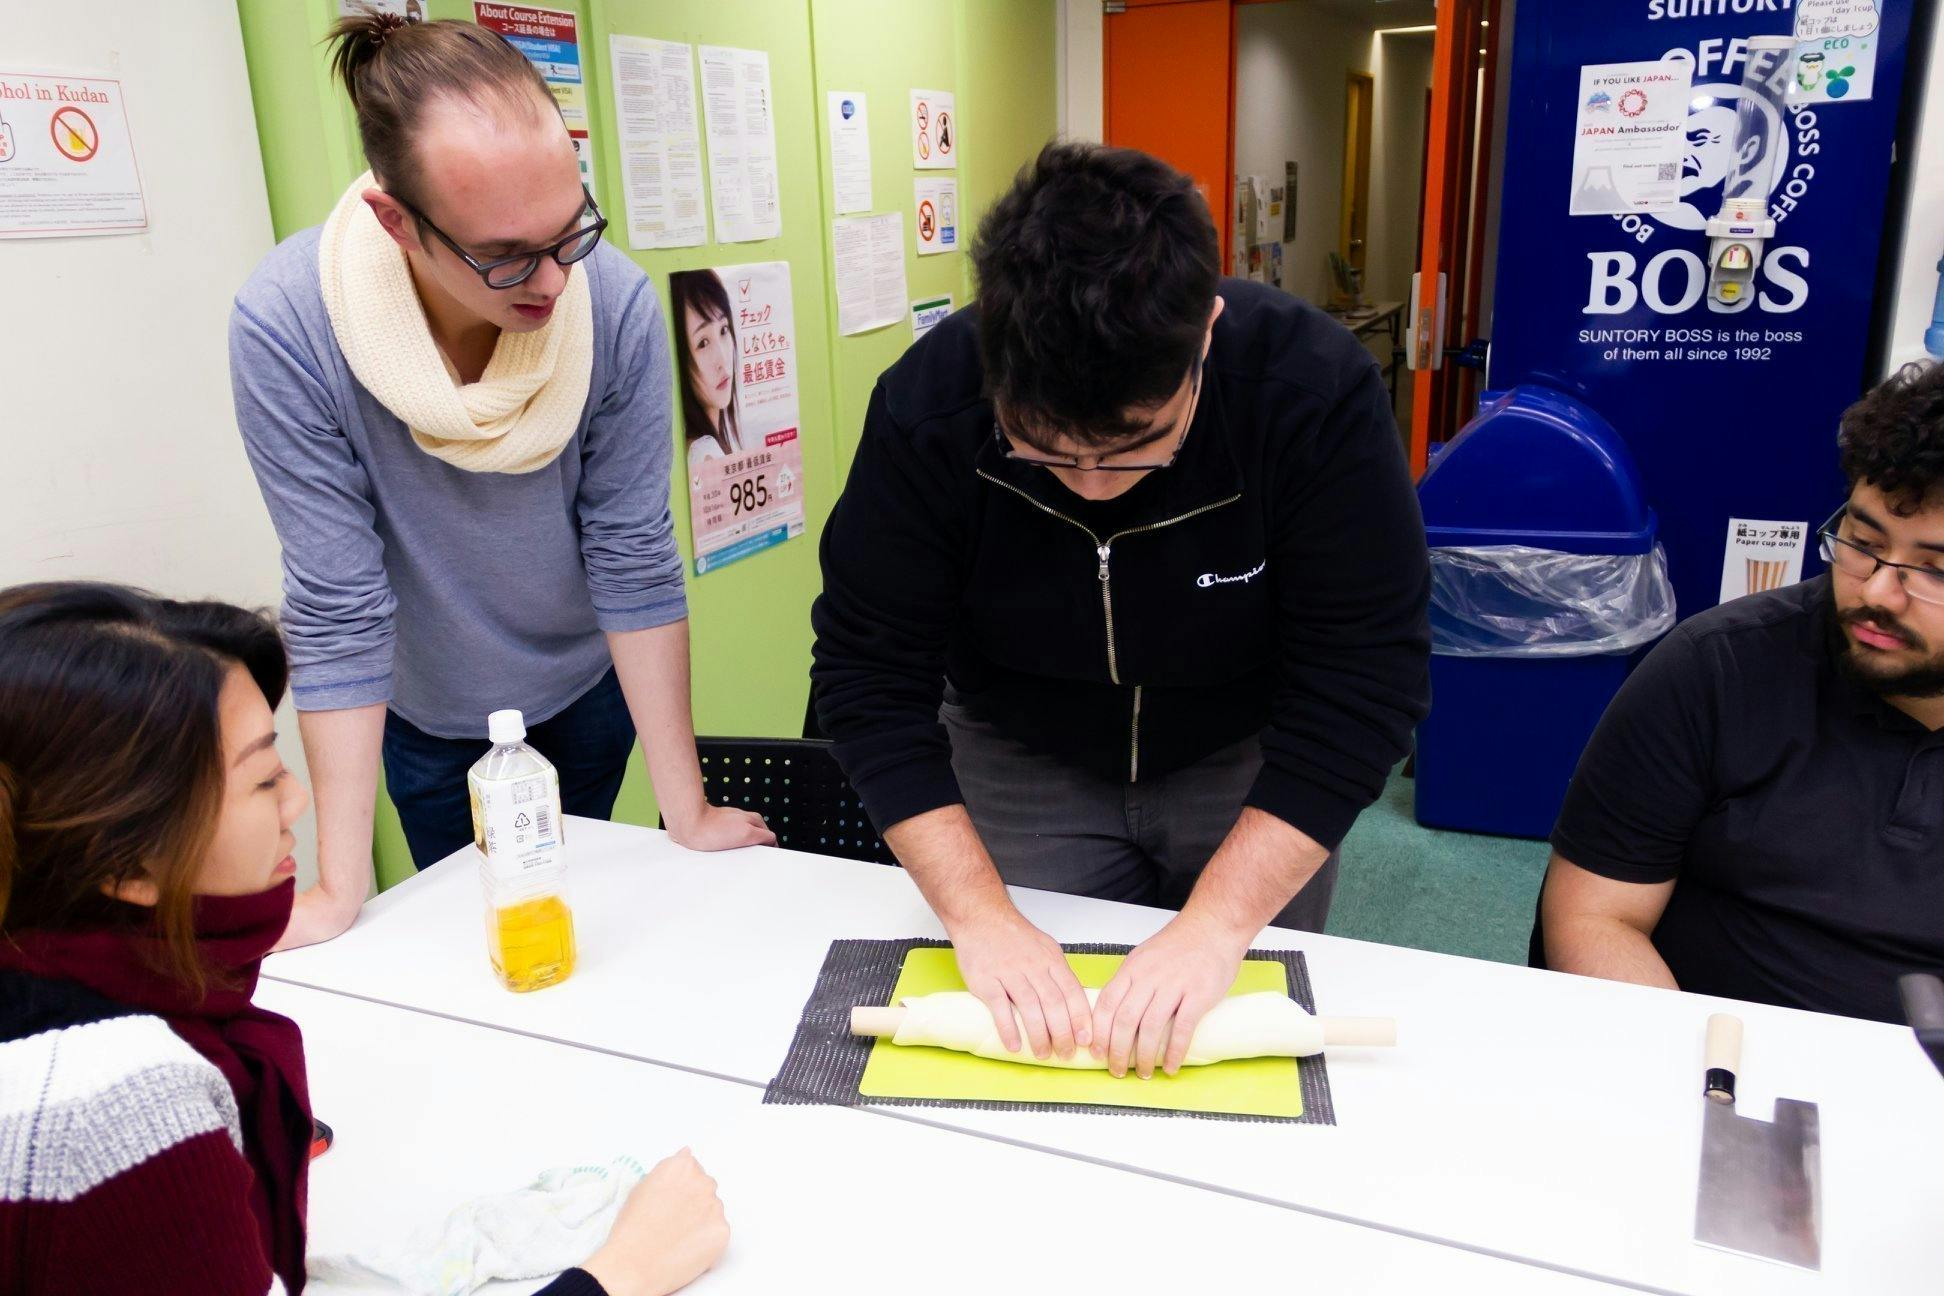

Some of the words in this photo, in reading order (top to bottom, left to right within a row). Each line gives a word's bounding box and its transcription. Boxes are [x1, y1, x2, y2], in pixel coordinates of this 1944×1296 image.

[480, 4, 507, 20] About
[509, 8, 537, 22] Course
[539, 12, 574, 27] Extension
[1824, 38, 1849, 50] eco
[35, 83, 53, 101] in
[56, 84, 109, 104] Kudan
[1581, 127, 1616, 136] JAPAN
[1617, 124, 1680, 134] Ambassador
[1582, 246, 1810, 315] BOS
[741, 304, 771, 325] チェック
[1579, 329, 1660, 343] SUNTORY
[1665, 329, 1713, 342] BOSS
[1717, 329, 1730, 342] is
[1735, 329, 1759, 342] the
[1764, 329, 1803, 342] boss
[1603, 347, 1619, 360] of
[1622, 348, 1660, 360] them
[1664, 348, 1683, 360] all
[1687, 348, 1728, 360] since
[1734, 348, 1771, 360] 1992
[743, 357, 785, 383] 最低賃金
[1737, 528, 1800, 540] 紙コップ専用
[1736, 537, 1760, 546] Paper
